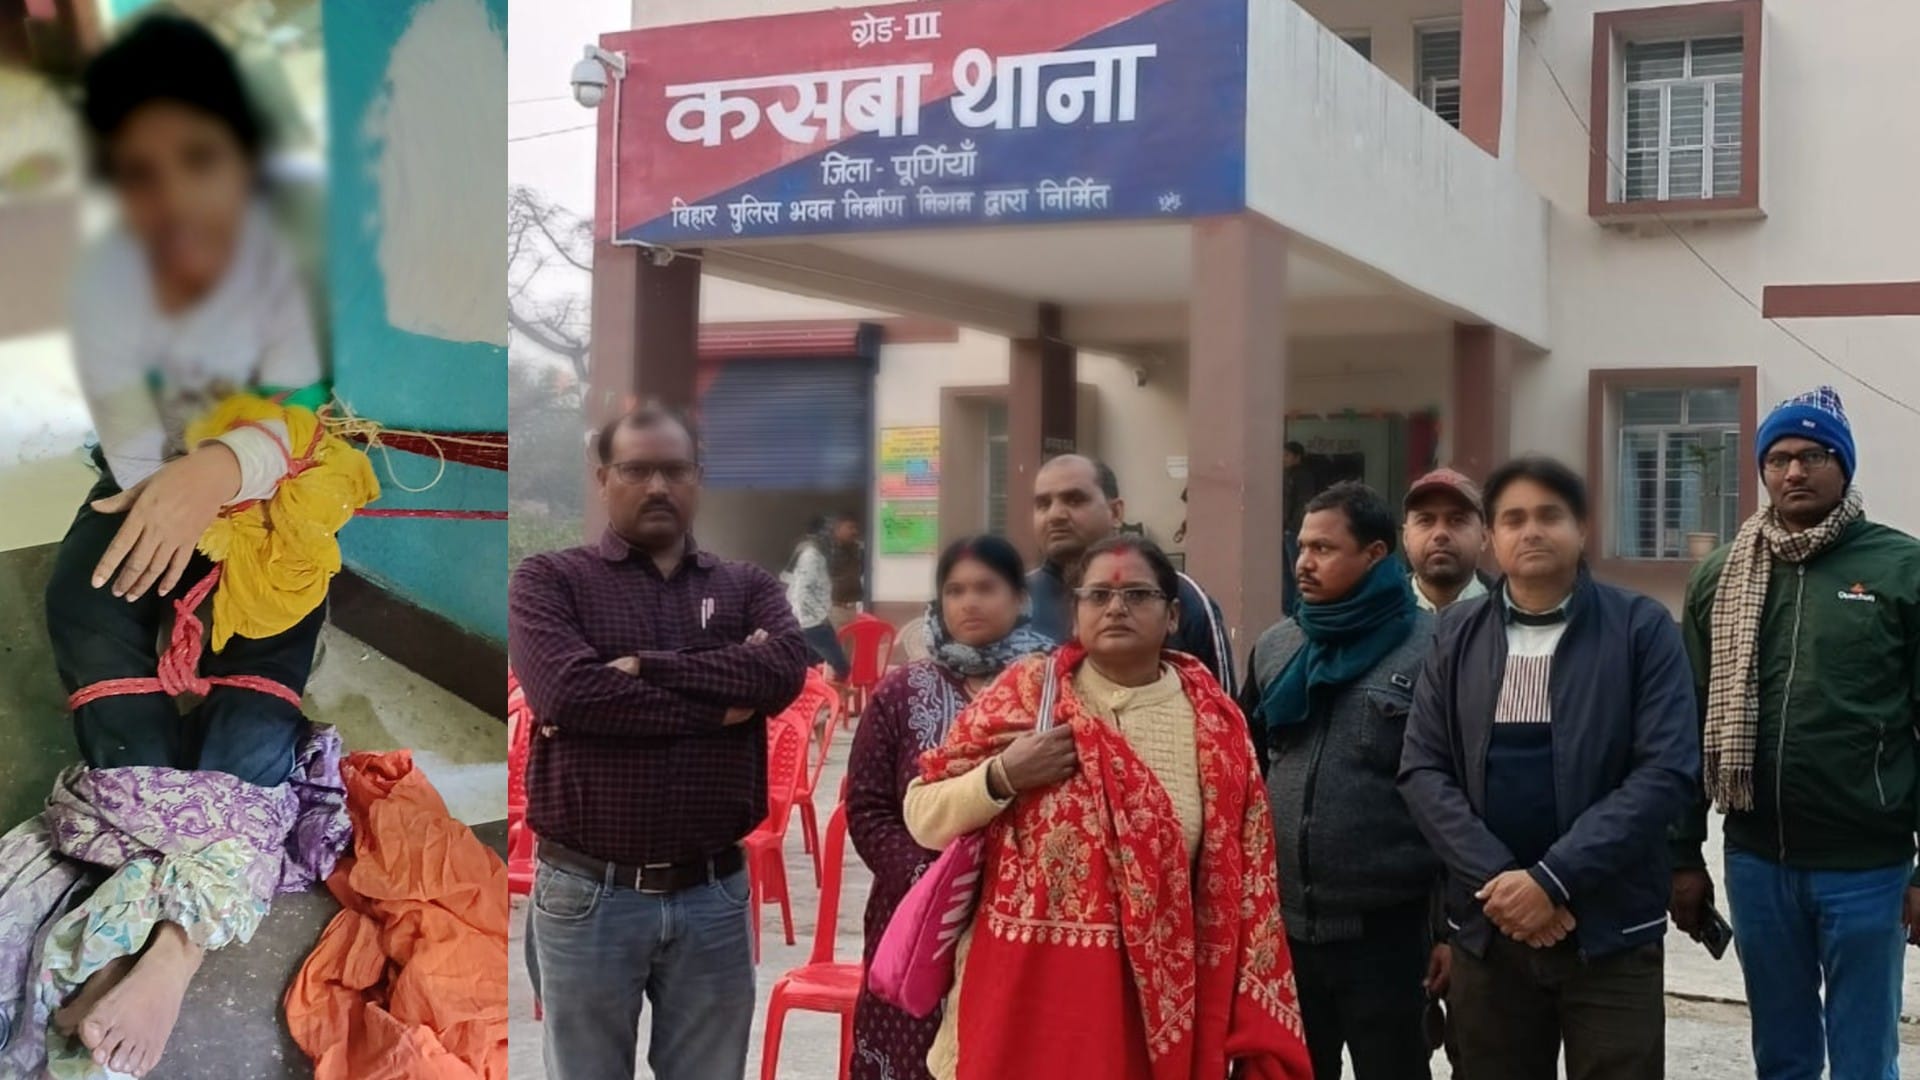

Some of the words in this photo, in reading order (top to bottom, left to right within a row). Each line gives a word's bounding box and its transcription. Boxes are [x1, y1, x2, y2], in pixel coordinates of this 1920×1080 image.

[665, 62, 933, 147] कसबा
[951, 44, 1157, 130] थाना
[671, 197, 717, 230] बिहार
[728, 194, 782, 233] पुलिस
[789, 198, 835, 225] भवन
[842, 189, 906, 219] निर्माण
[916, 185, 975, 214] निगम
[984, 188, 1029, 216] द्वारा
[1036, 177, 1111, 211] निर्मित
